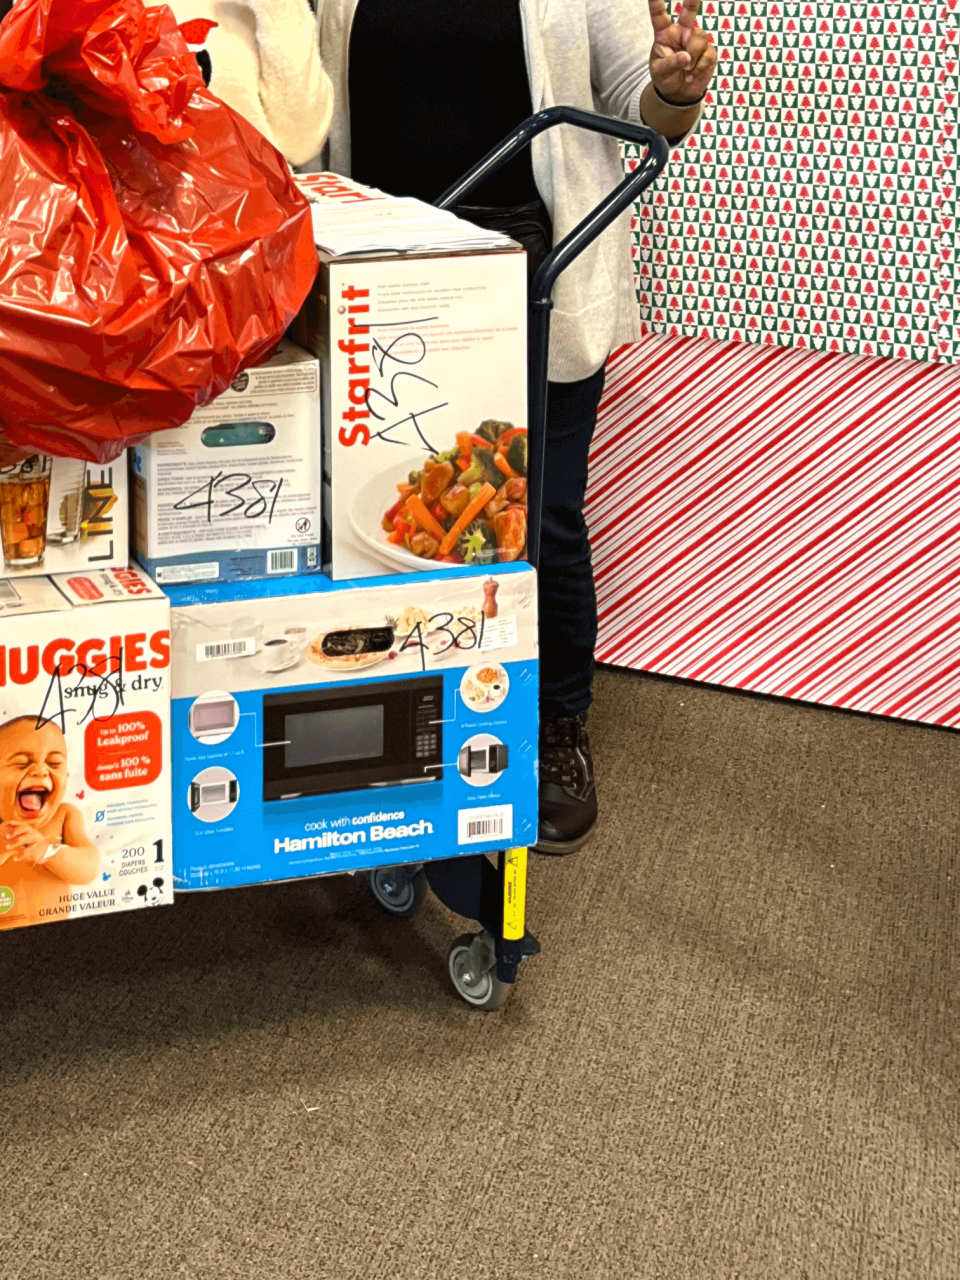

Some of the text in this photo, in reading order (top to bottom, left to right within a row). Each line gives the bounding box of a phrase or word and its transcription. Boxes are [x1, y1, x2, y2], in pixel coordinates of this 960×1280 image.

[338, 285, 370, 447] Starfrit
[173, 471, 284, 525] 4381
[399, 610, 485, 671] 4381
[131, 674, 163, 692] dry
[117, 721, 146, 733] 100%
[97, 730, 150, 747] Leakproof
[121, 756, 139, 768] 100
[140, 755, 151, 764] %
[99, 767, 148, 782] sans fuite
[304, 810, 405, 832] cook with confidence
[273, 819, 434, 854] Hamilton Beach
[121, 838, 165, 864] 200 1
[118, 865, 148, 877] COUCHES
[121, 858, 146, 869] DIAPERS
[58, 887, 116, 904] HUGE VALUE
[38, 898, 116, 917] GRANDE VALEUR
